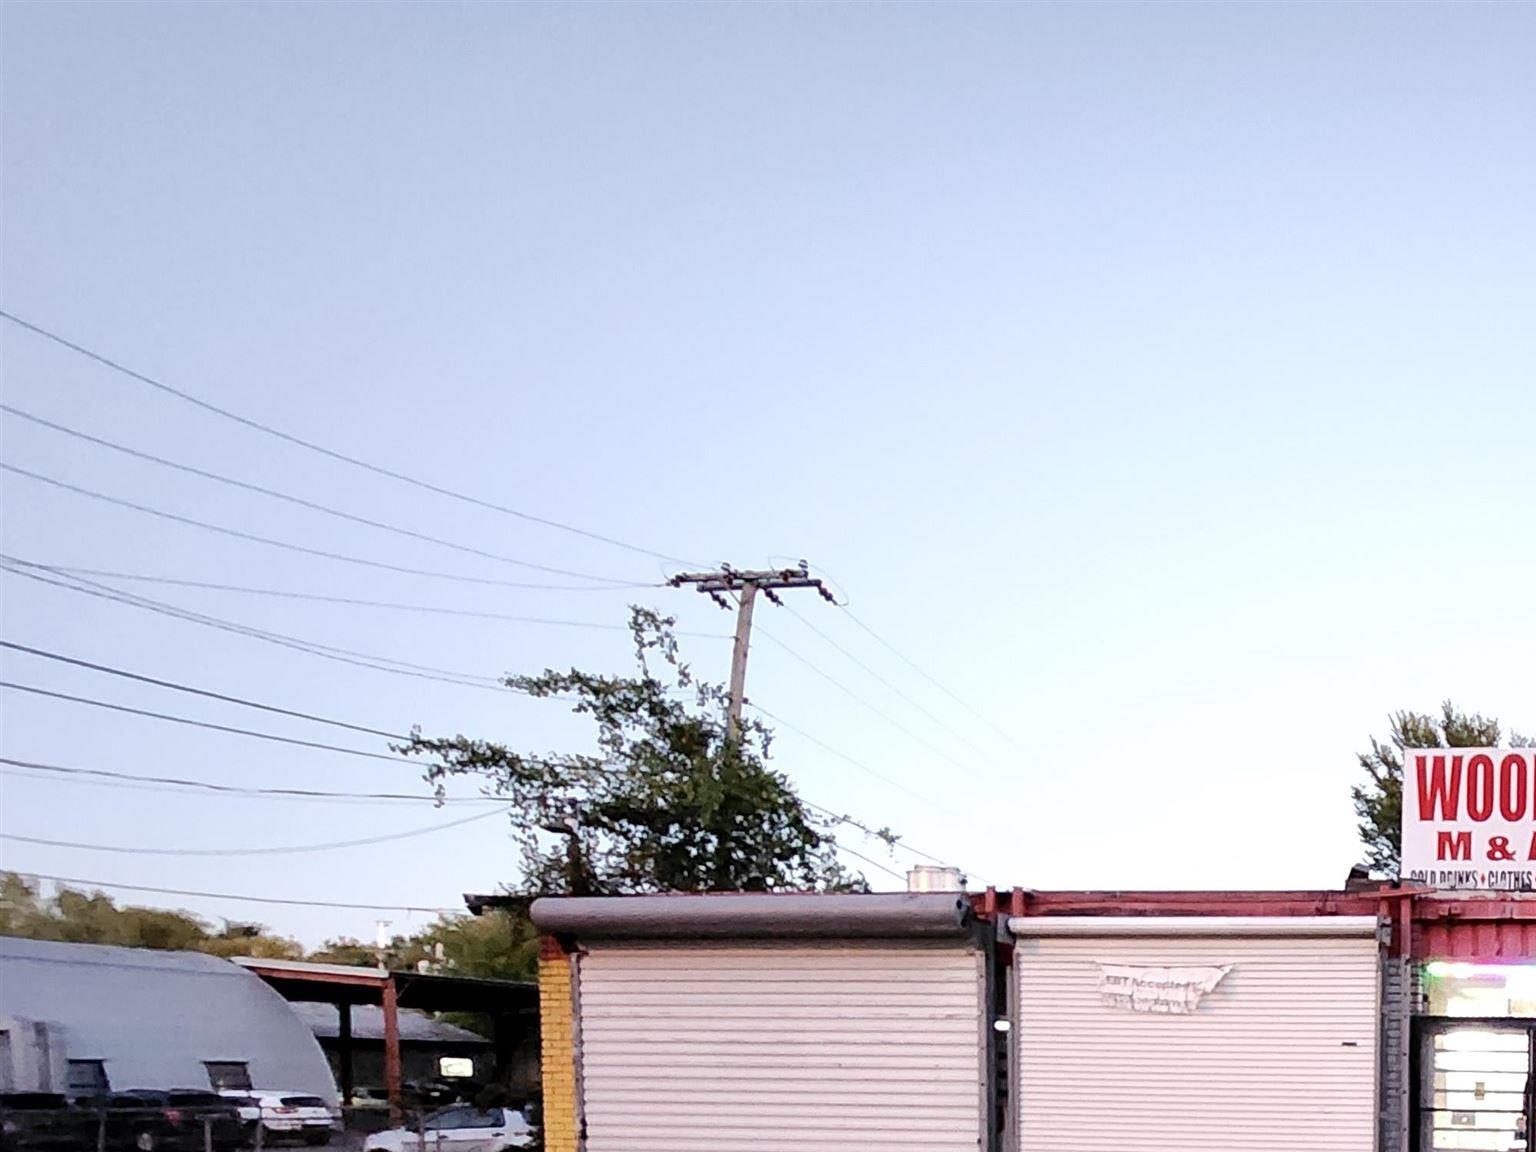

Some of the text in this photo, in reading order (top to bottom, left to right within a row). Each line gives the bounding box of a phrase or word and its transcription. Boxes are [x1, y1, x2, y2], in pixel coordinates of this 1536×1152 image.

[1436, 830, 1473, 861] M
[1485, 835, 1517, 861] &
[1487, 869, 1533, 890] CLOTHES
